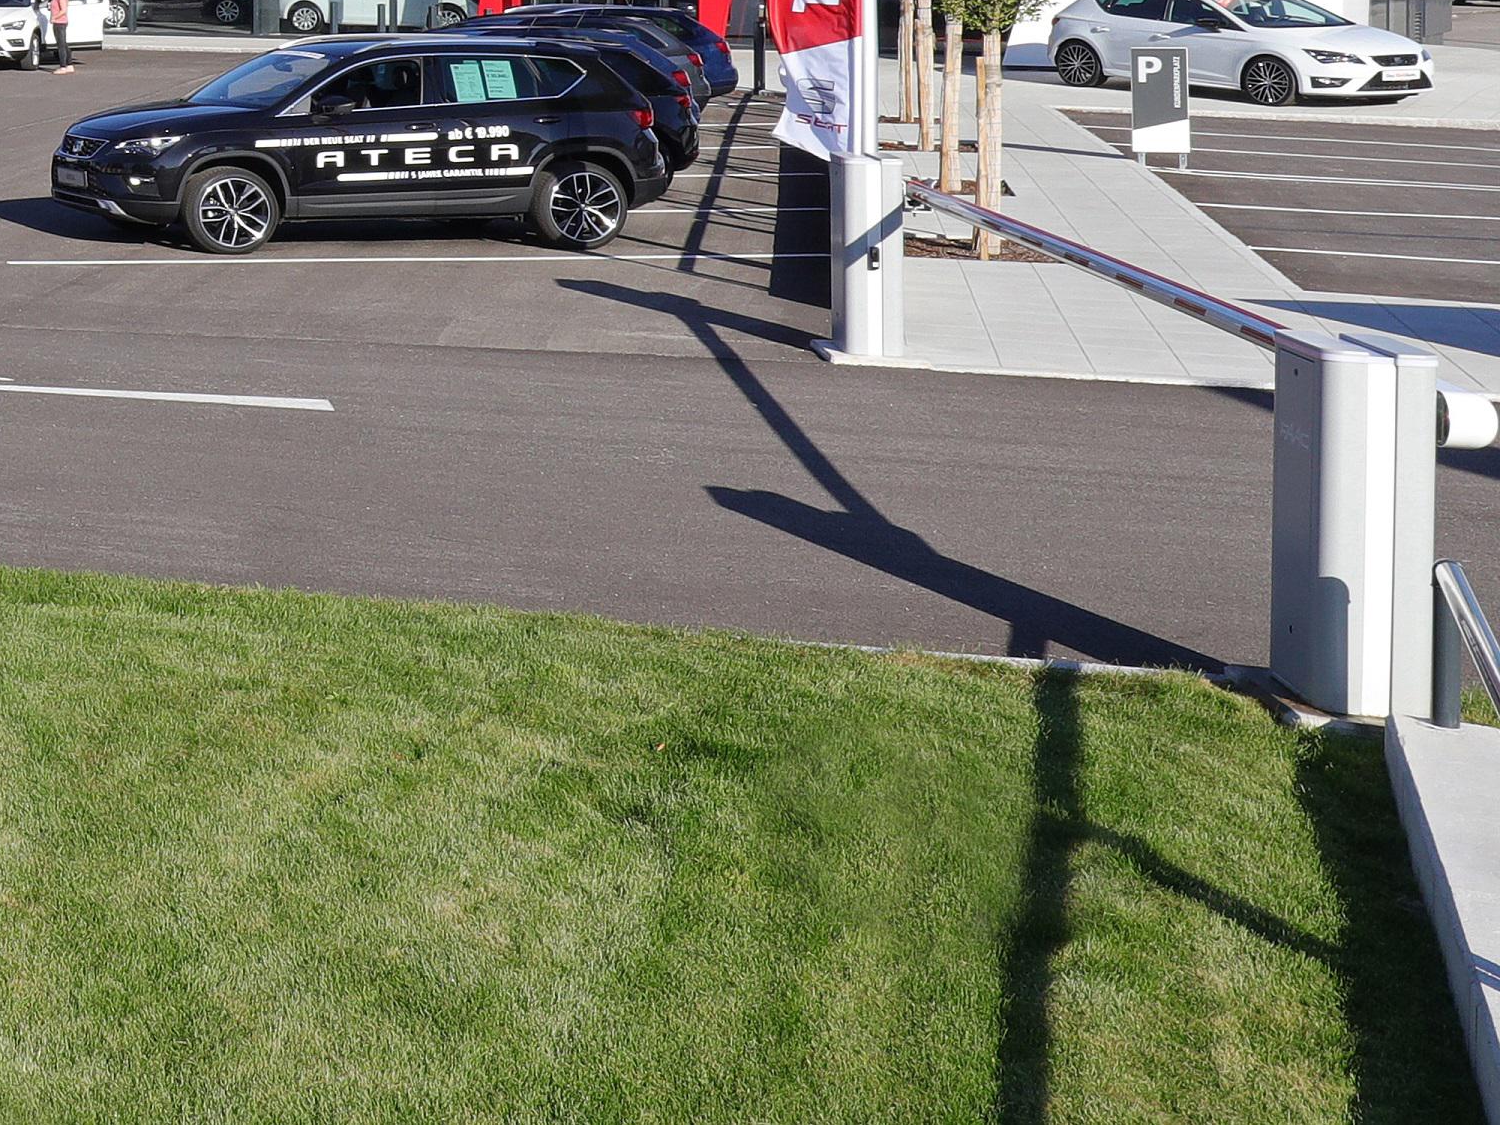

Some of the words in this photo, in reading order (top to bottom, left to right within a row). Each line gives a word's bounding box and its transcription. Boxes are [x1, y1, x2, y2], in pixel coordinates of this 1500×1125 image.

[1137, 56, 1162, 83] P
[447, 127, 463, 140] ab
[464, 127, 473, 139] €
[303, 137, 320, 146] DER
[321, 136, 343, 145] NEUE
[343, 135, 365, 144] SEAT
[316, 143, 519, 168] ATECA
[443, 168, 483, 178] GARANTIE
